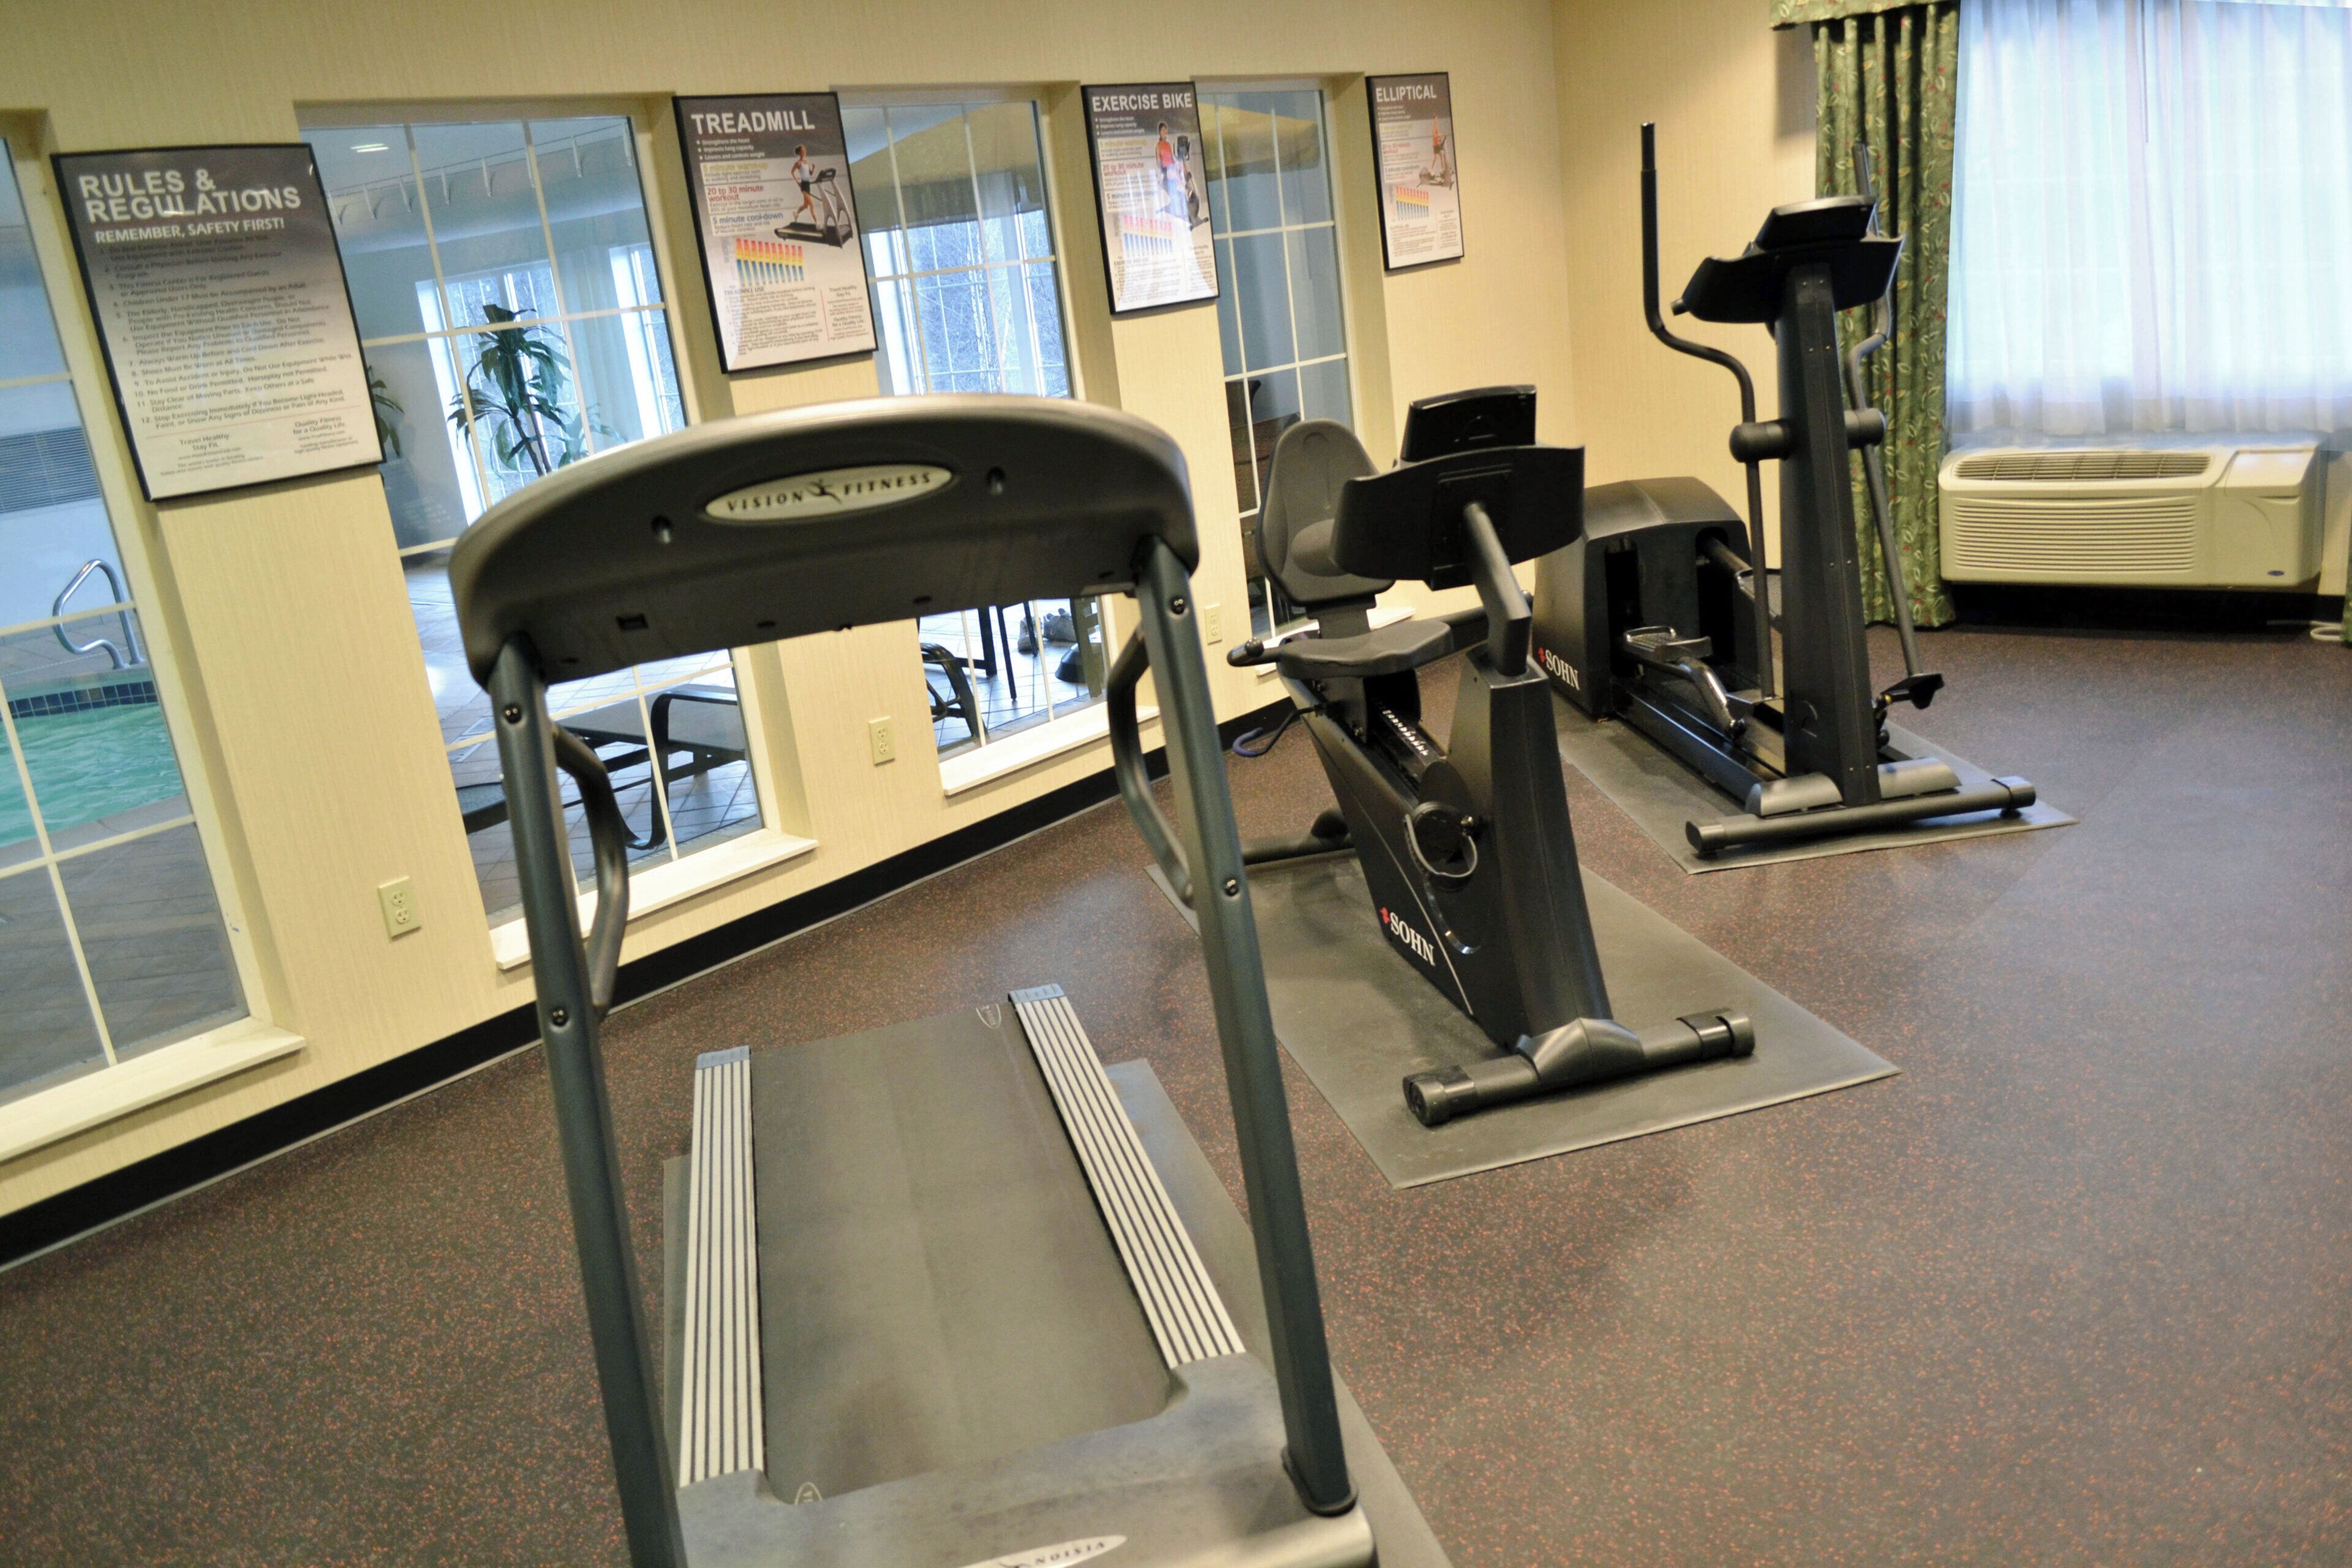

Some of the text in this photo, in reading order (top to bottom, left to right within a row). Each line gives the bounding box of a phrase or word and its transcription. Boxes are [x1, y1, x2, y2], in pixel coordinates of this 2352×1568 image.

[1376, 84, 1437, 103] ELLIPTICAL
[1091, 92, 1193, 113] EXERCISE BIKE
[690, 110, 816, 135] TREADMILL
[78, 168, 217, 198] RULES &
[85, 186, 301, 224] REGULATIONS
[747, 212, 783, 221] cool-down
[94, 225, 185, 244] REMEMBER,
[187, 221, 239, 236] SAFETY
[242, 217, 285, 232] FIRST!
[145, 321, 184, 331] Equipment
[175, 326, 213, 336] Equipment
[161, 344, 184, 353] Report
[139, 357, 165, 366] Always
[282, 358, 317, 368] Equipment
[248, 373, 280, 382] Horseplay
[196, 391, 221, 399] Moving
[172, 409, 207, 420] Exercising
[295, 419, 317, 428] Quality
[309, 424, 332, 432] Quality
[727, 472, 931, 512] VISION FITNESS
[1545, 649, 1580, 691] SOHN
[1389, 911, 1436, 967] SOHN
[1035, 1541, 1106, 1564] VISION
